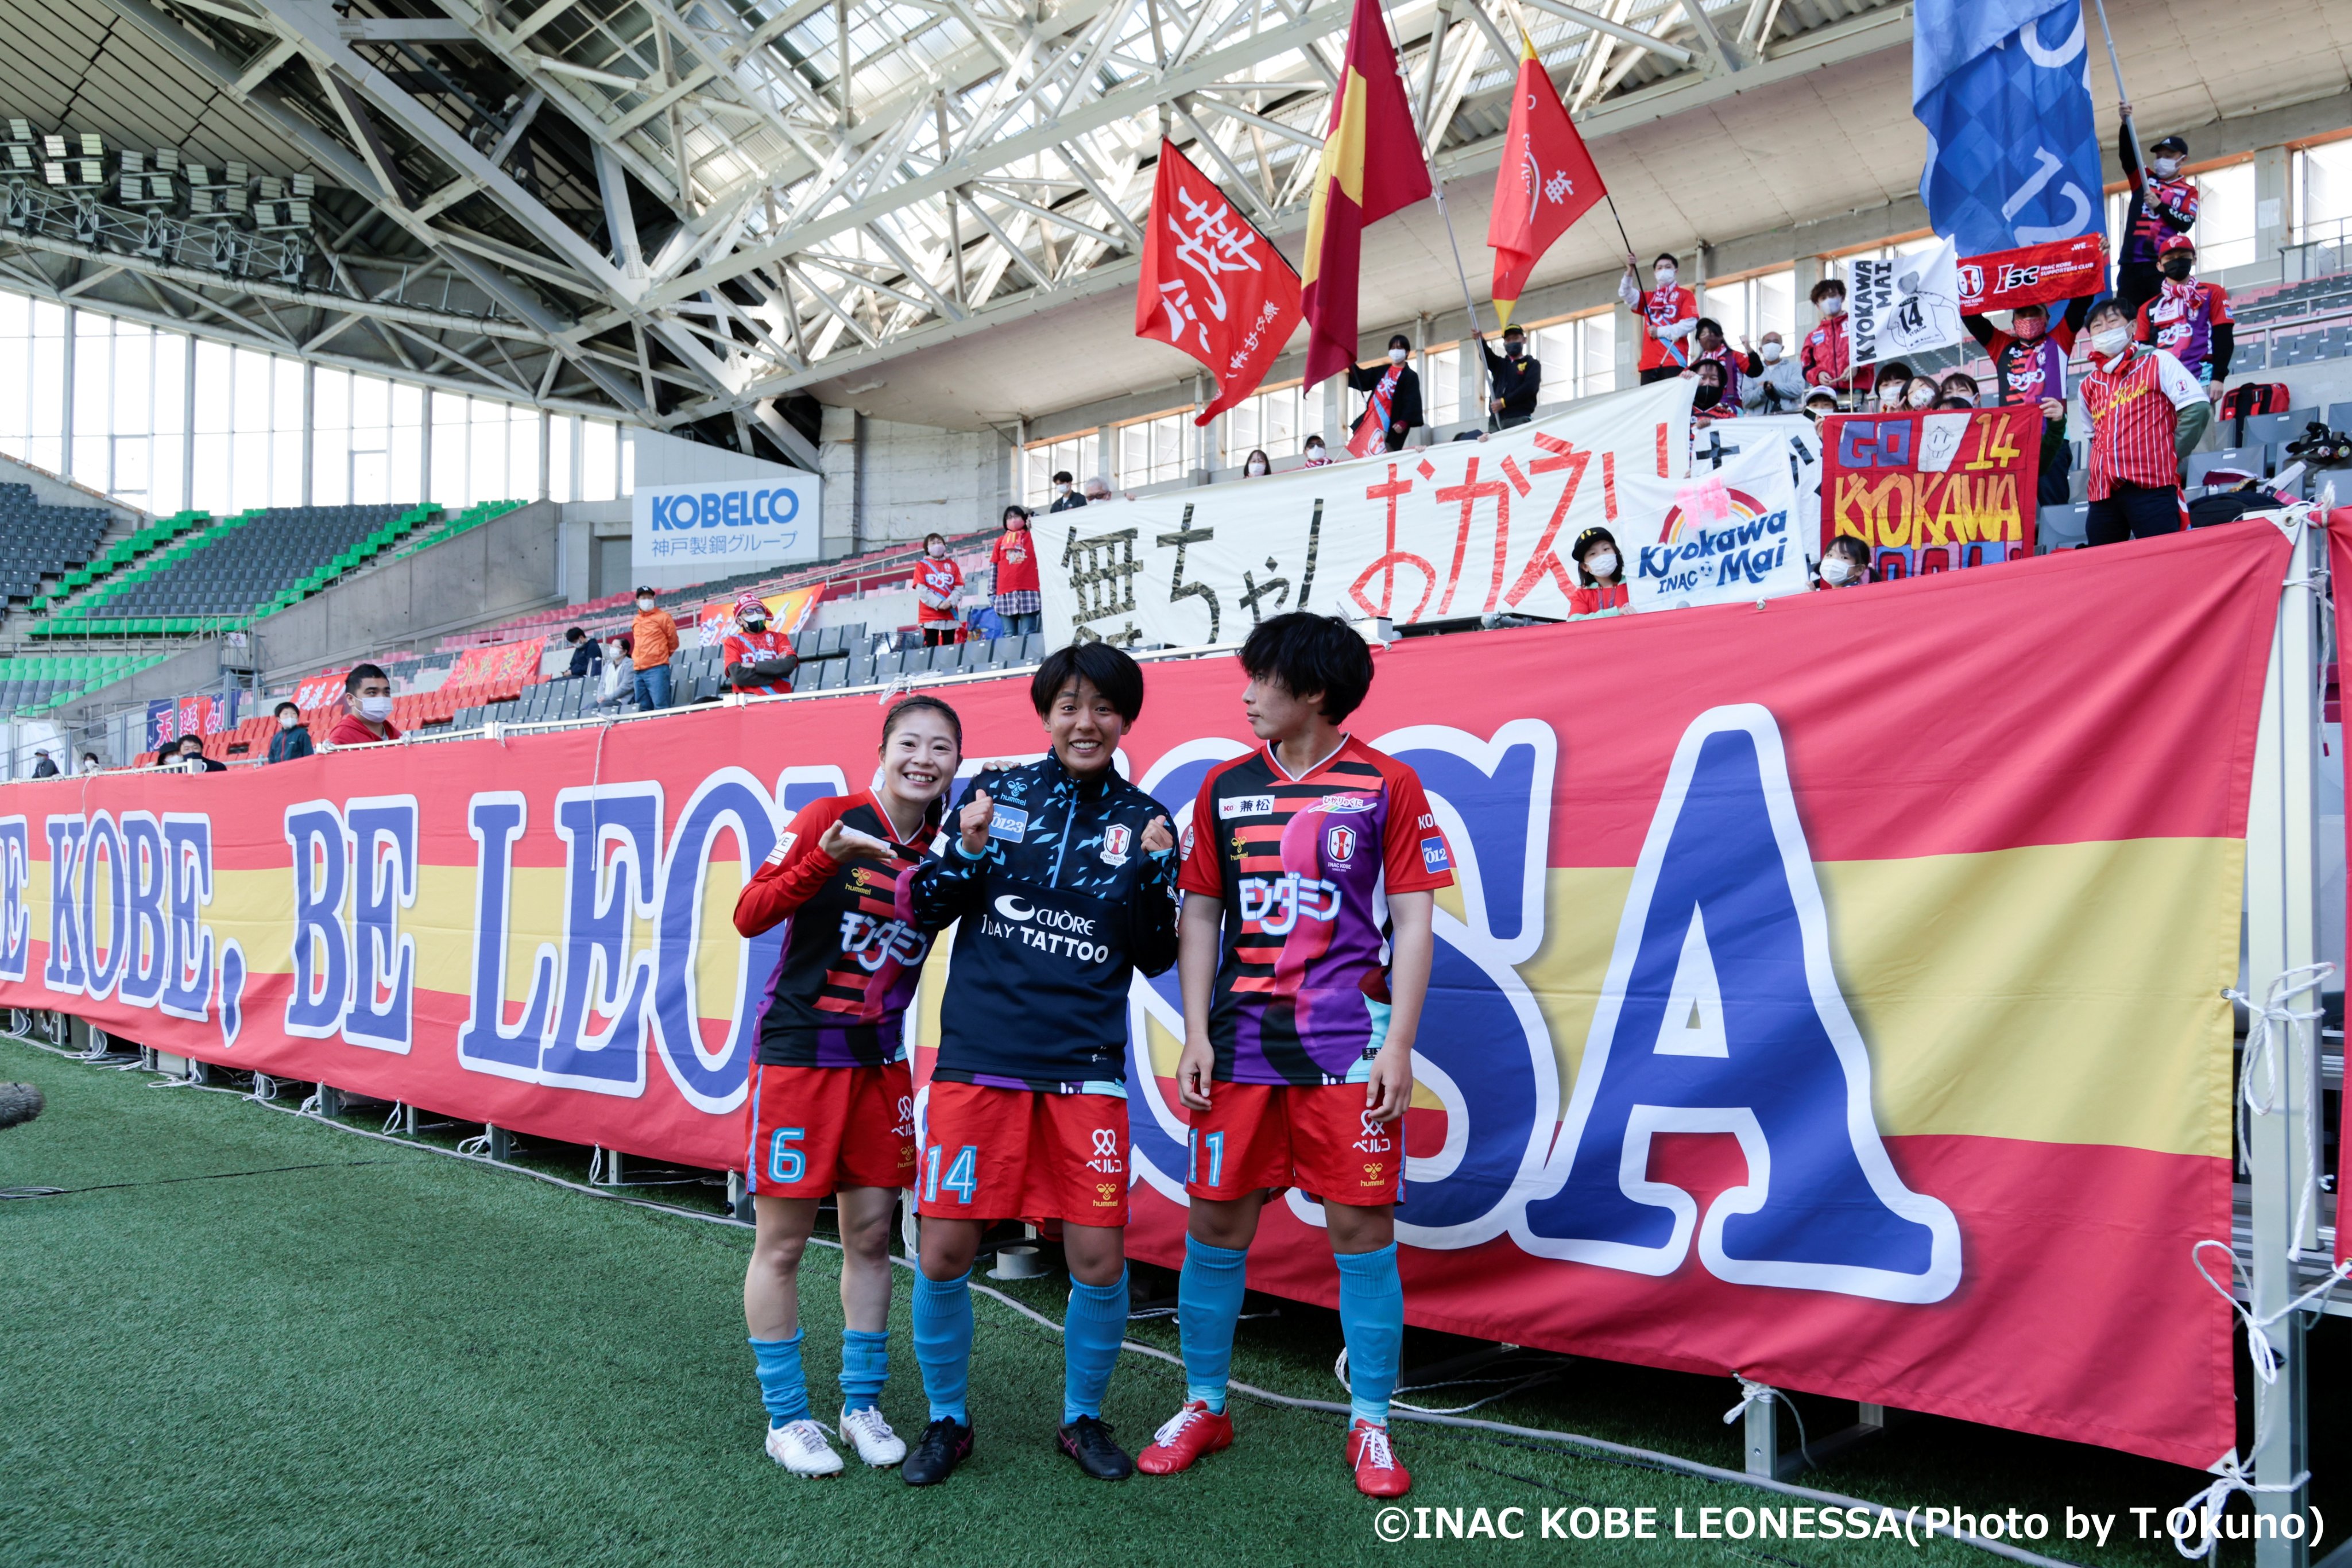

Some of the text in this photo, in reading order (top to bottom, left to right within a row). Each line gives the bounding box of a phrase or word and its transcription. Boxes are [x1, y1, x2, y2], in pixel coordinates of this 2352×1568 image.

[1874, 262, 1892, 309] MAI
[2040, 266, 2077, 277] SUPPORTERS
[1855, 260, 1877, 362] KYOKAWA
[1898, 302, 1924, 335] 14
[1839, 412, 2021, 470] GO 14
[652, 487, 799, 531] KOBELCO
[1835, 471, 2022, 549] KYOKAWA
[651, 531, 798, 558] 神戸製鋼グループ
[1638, 510, 1788, 578] Kyokawa
[1716, 537, 1788, 587] Mai
[1657, 570, 1699, 594] INAC
[1000, 793, 1027, 807] hummel
[1240, 799, 1271, 813] 兼松
[992, 818, 1024, 834] 0123
[1417, 813, 1437, 830] KO
[1231, 852, 1249, 861] hummel
[845, 882, 872, 896] hummel
[1239, 872, 1342, 936] モンダミン
[44, 808, 247, 1048] KOBE,
[284, 793, 419, 1056] BE
[1036, 908, 1096, 937] CUÒRE
[838, 910, 928, 973] モンダミン
[1019, 925, 1109, 964] TATTOO
[768, 1127, 805, 1183] 6
[1187, 1128, 1224, 1187] 11
[1352, 1138, 1391, 1153] ベルコ
[924, 1145, 977, 1205] 14
[1085, 1159, 1122, 1174] ベルコ
[1360, 1179, 1385, 1187] hummel
[1093, 1199, 1118, 1207] hummel
